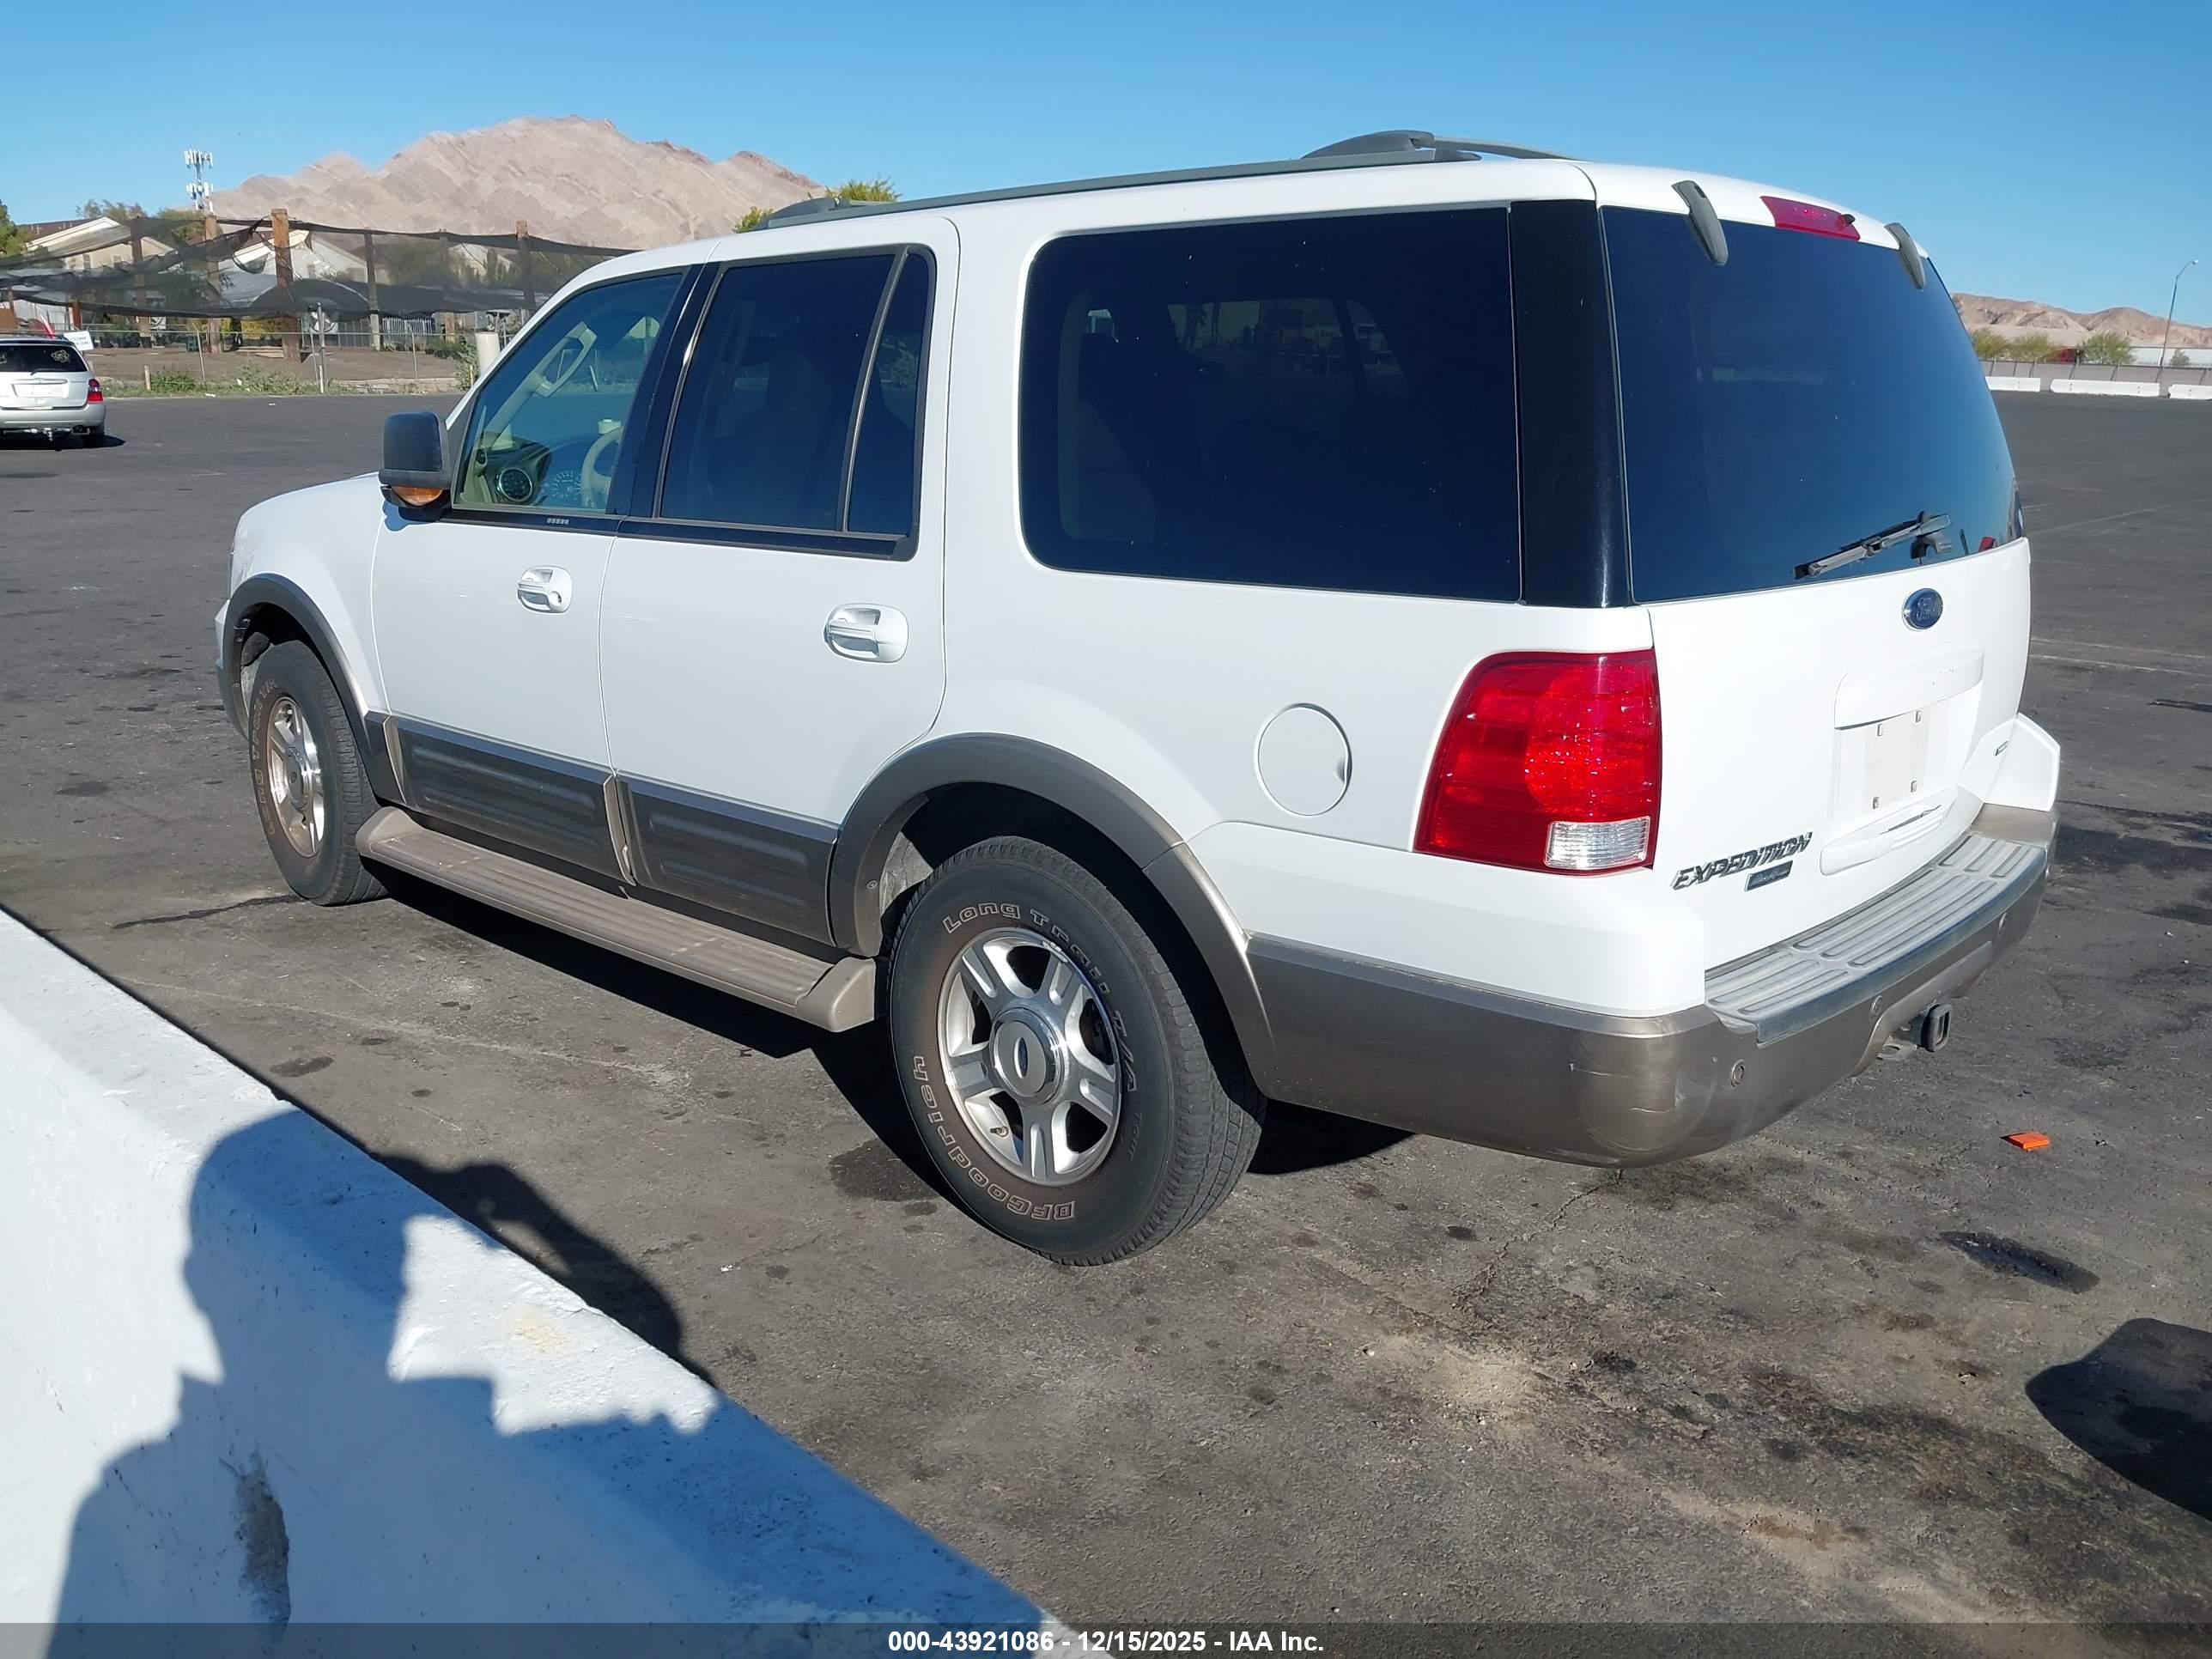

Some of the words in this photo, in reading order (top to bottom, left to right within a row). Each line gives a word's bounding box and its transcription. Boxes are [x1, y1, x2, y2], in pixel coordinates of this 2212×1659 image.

[1670, 831, 1813, 890] EXPEDITION
[943, 902, 1021, 934] Long
[1113, 1010, 1137, 1091] T/A
